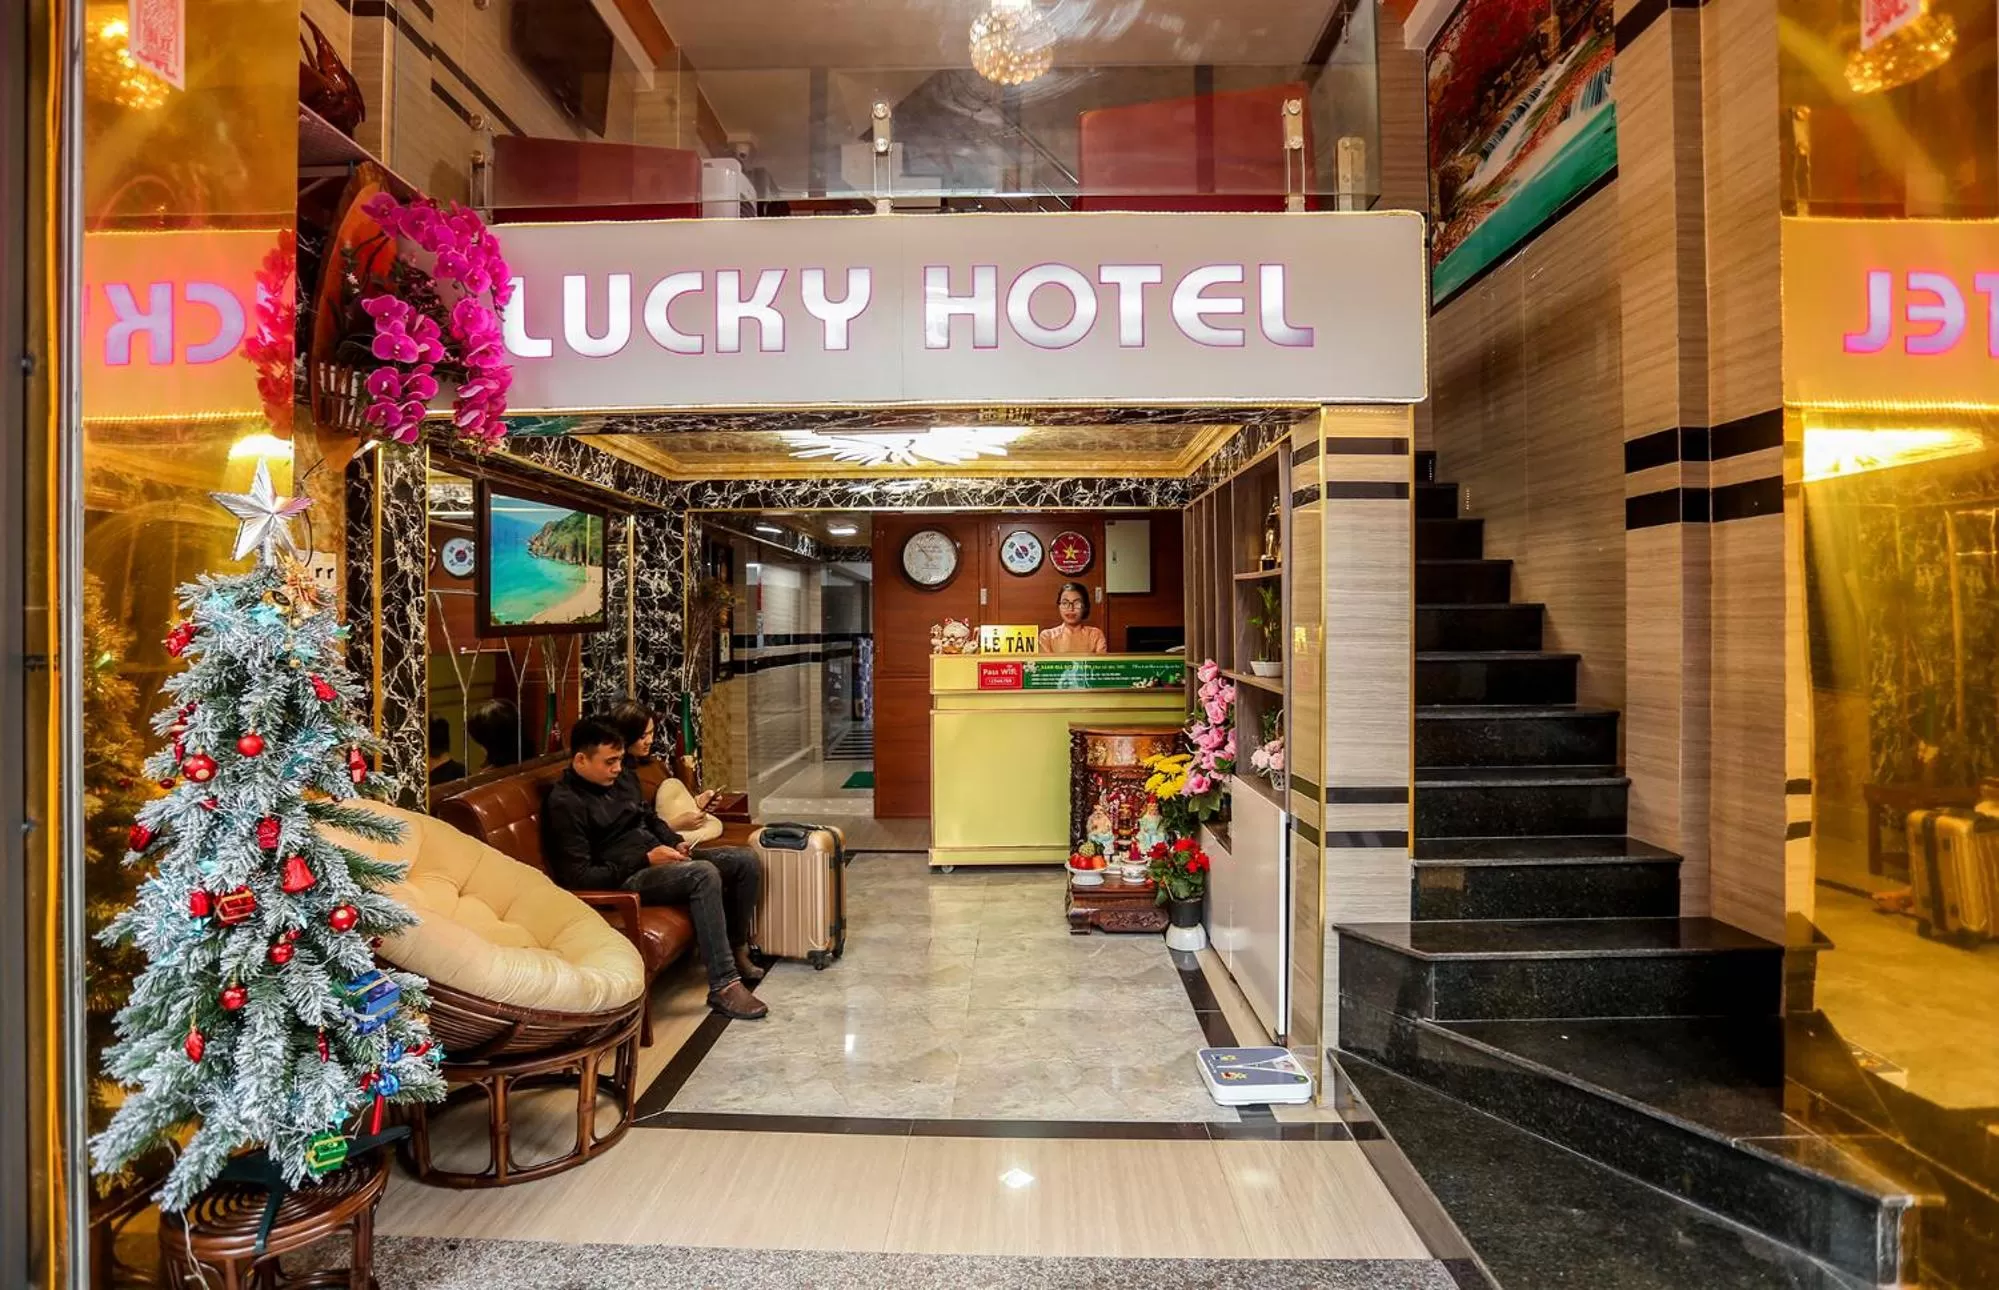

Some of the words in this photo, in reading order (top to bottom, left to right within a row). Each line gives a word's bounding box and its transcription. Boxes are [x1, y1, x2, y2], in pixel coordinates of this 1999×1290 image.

[502, 267, 873, 358] LUCKY
[924, 262, 1315, 350] HOTEL
[1006, 631, 1035, 653] TÂN
